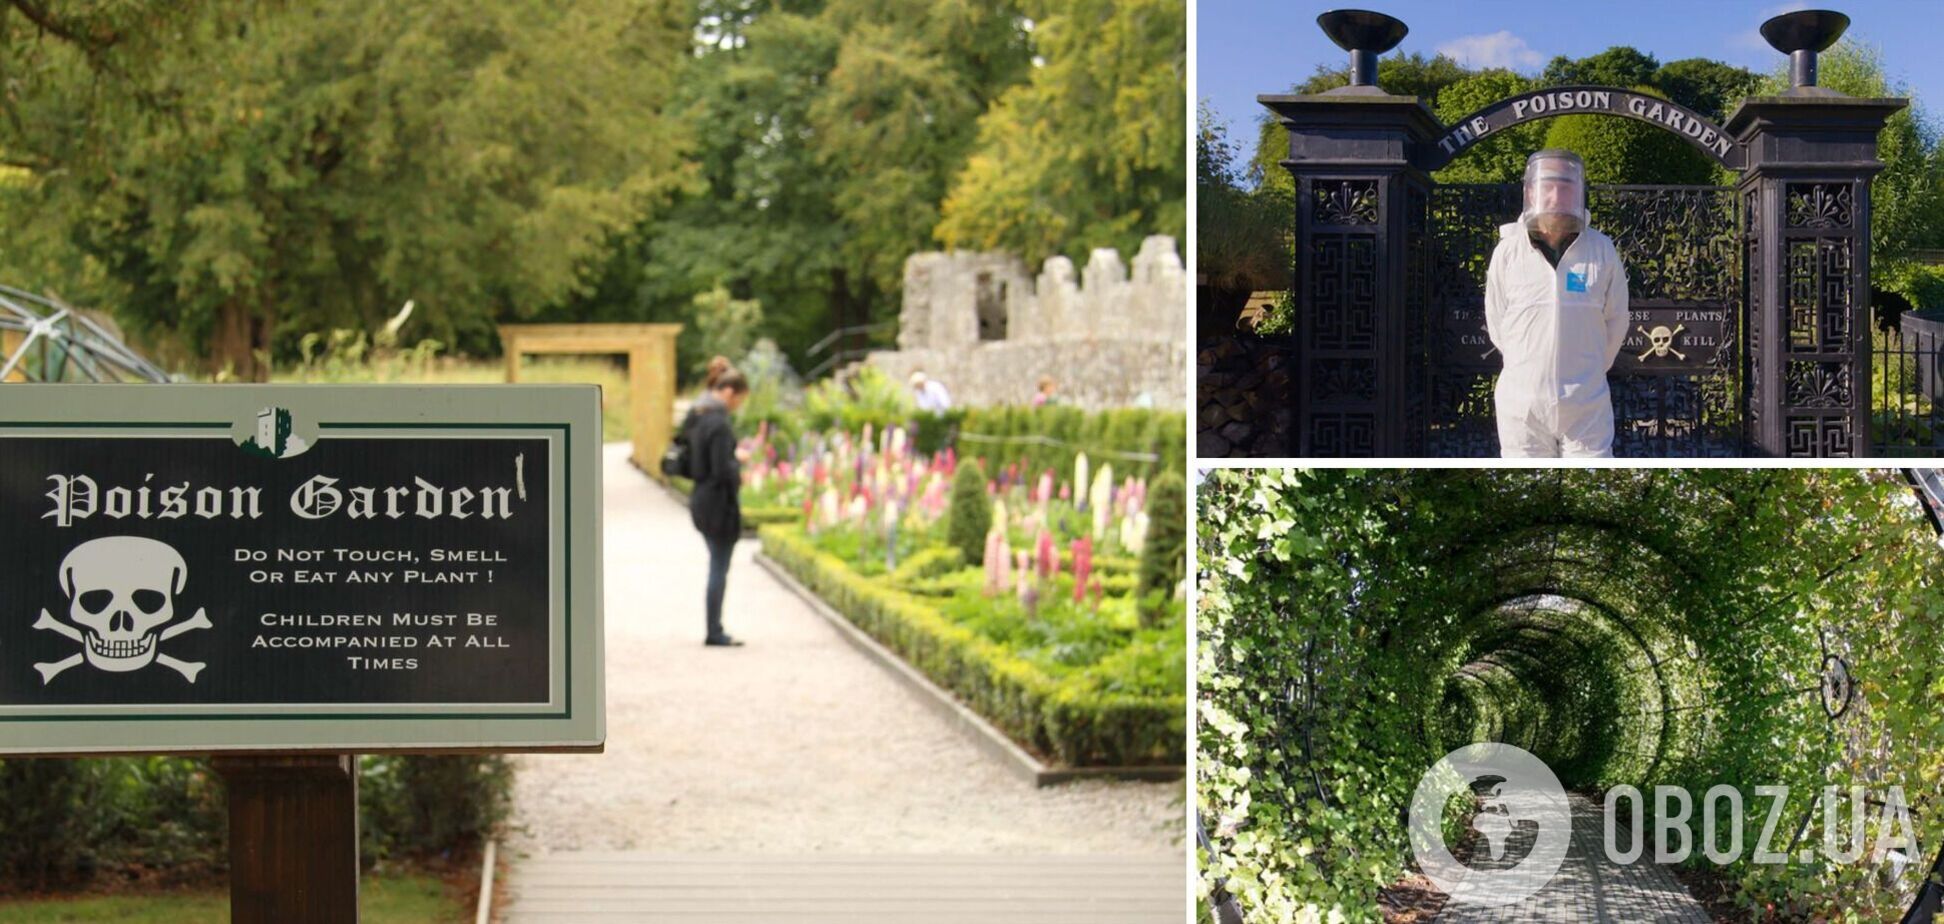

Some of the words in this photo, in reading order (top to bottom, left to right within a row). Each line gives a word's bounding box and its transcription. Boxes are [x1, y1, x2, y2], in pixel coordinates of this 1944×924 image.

[1438, 116, 1490, 155] THE
[1512, 91, 1612, 119] POISON
[1628, 98, 1733, 159] GARDEN
[1628, 311, 1650, 321] ESE
[1676, 311, 1723, 321] PLANTS
[1461, 335, 1486, 345] CAN
[1683, 336, 1716, 346] KILL
[41, 473, 263, 527] Poison
[290, 474, 513, 520] Garden
[234, 548, 268, 562] DO
[277, 548, 325, 562] NOT
[333, 548, 420, 564] TOUCH,
[430, 548, 507, 562] SMELL
[249, 570, 284, 583] OR
[294, 570, 337, 583] EAT
[346, 570, 394, 583] ANY
[404, 570, 478, 583] PLANT
[260, 613, 382, 626] CHILDREN
[392, 613, 457, 626] MUST
[467, 613, 498, 626] BE
[252, 634, 418, 648] ACCOMPANIED
[426, 634, 457, 648] AT
[464, 634, 510, 648] ALL
[347, 656, 419, 670] TIMES
